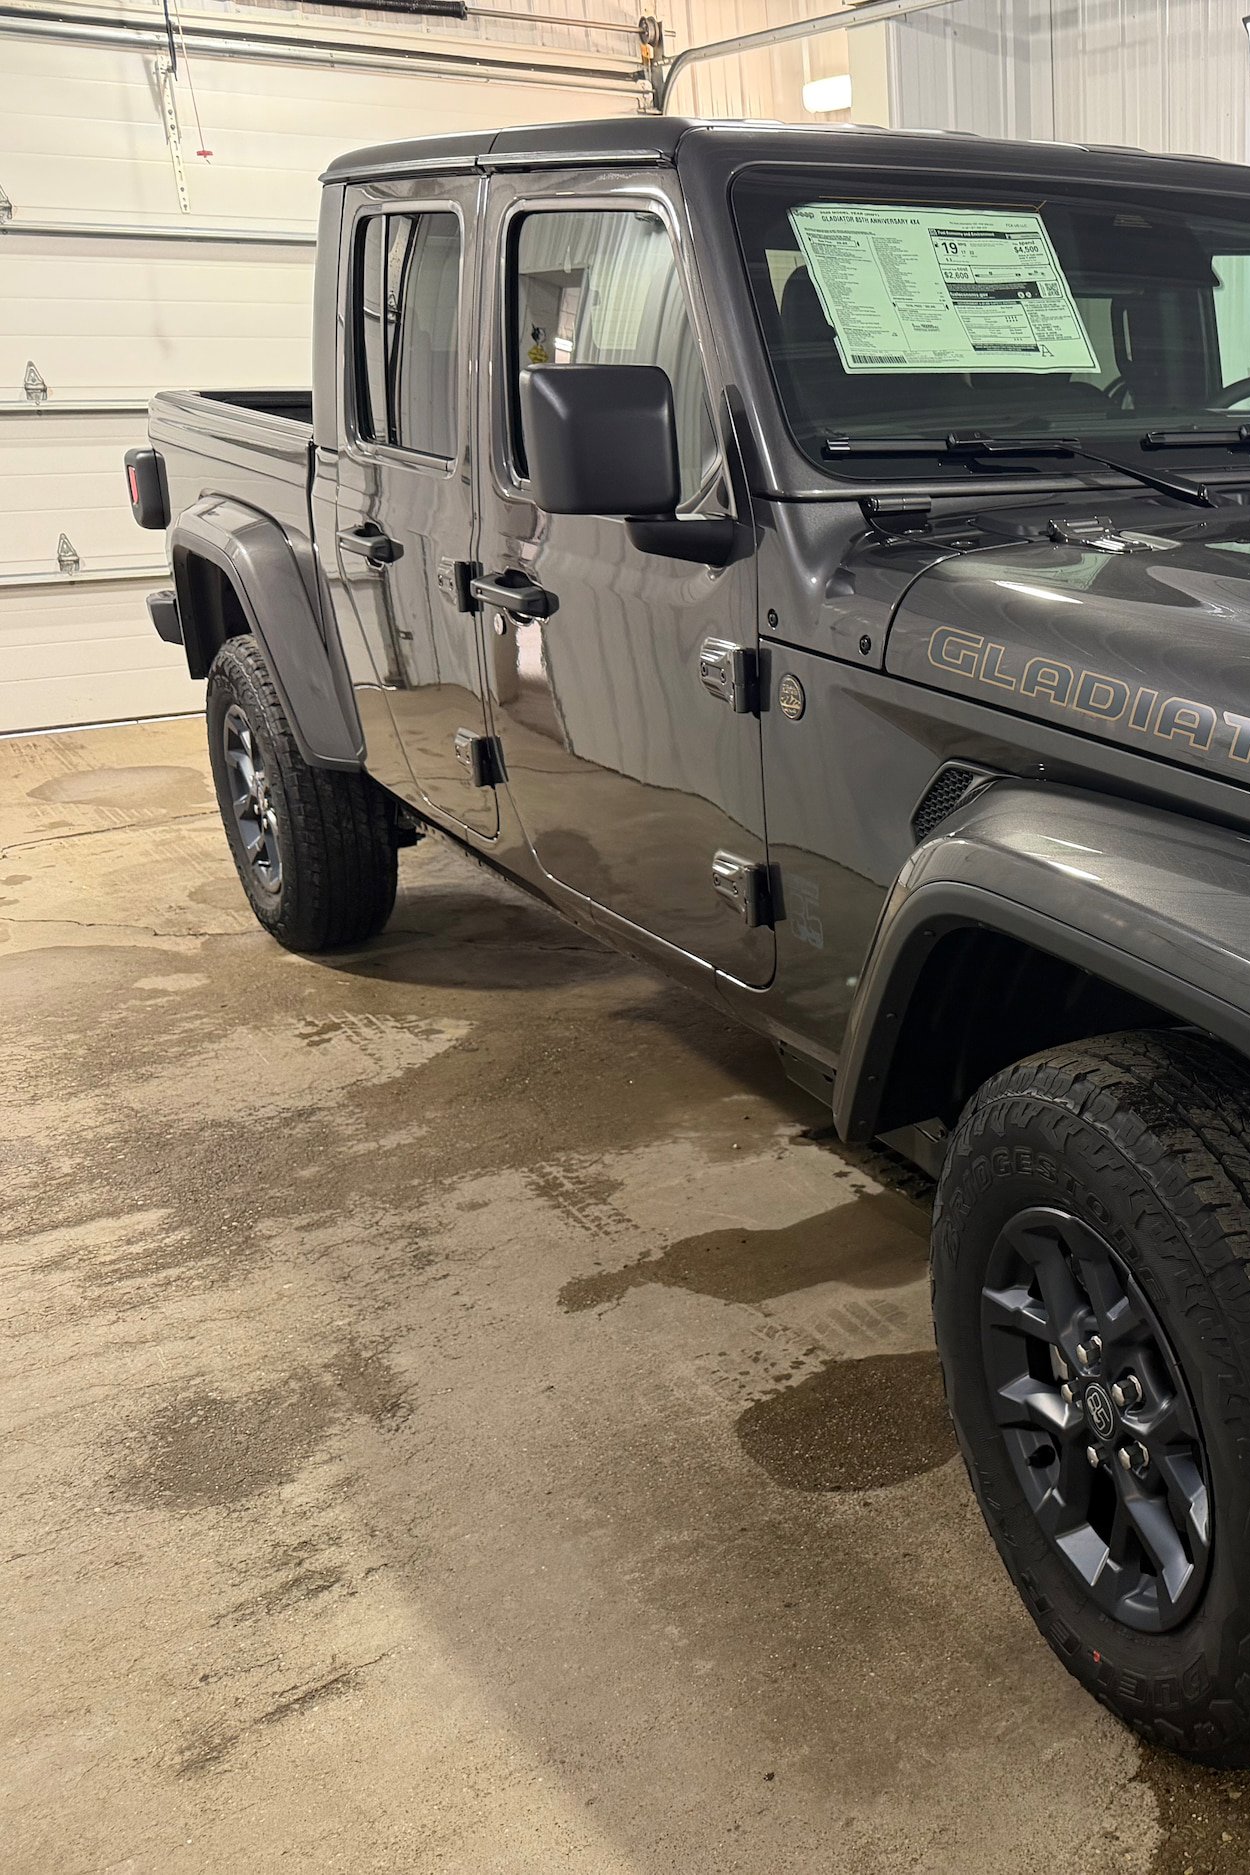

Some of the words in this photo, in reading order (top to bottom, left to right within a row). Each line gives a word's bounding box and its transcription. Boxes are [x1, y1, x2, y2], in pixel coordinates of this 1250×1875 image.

[821, 215, 854, 223] GLADIATOR
[870, 217, 908, 225] ANNIVERSARY
[941, 242, 958, 254] 19
[1013, 246, 1039, 254] $4,500
[944, 271, 969, 279] $2,600
